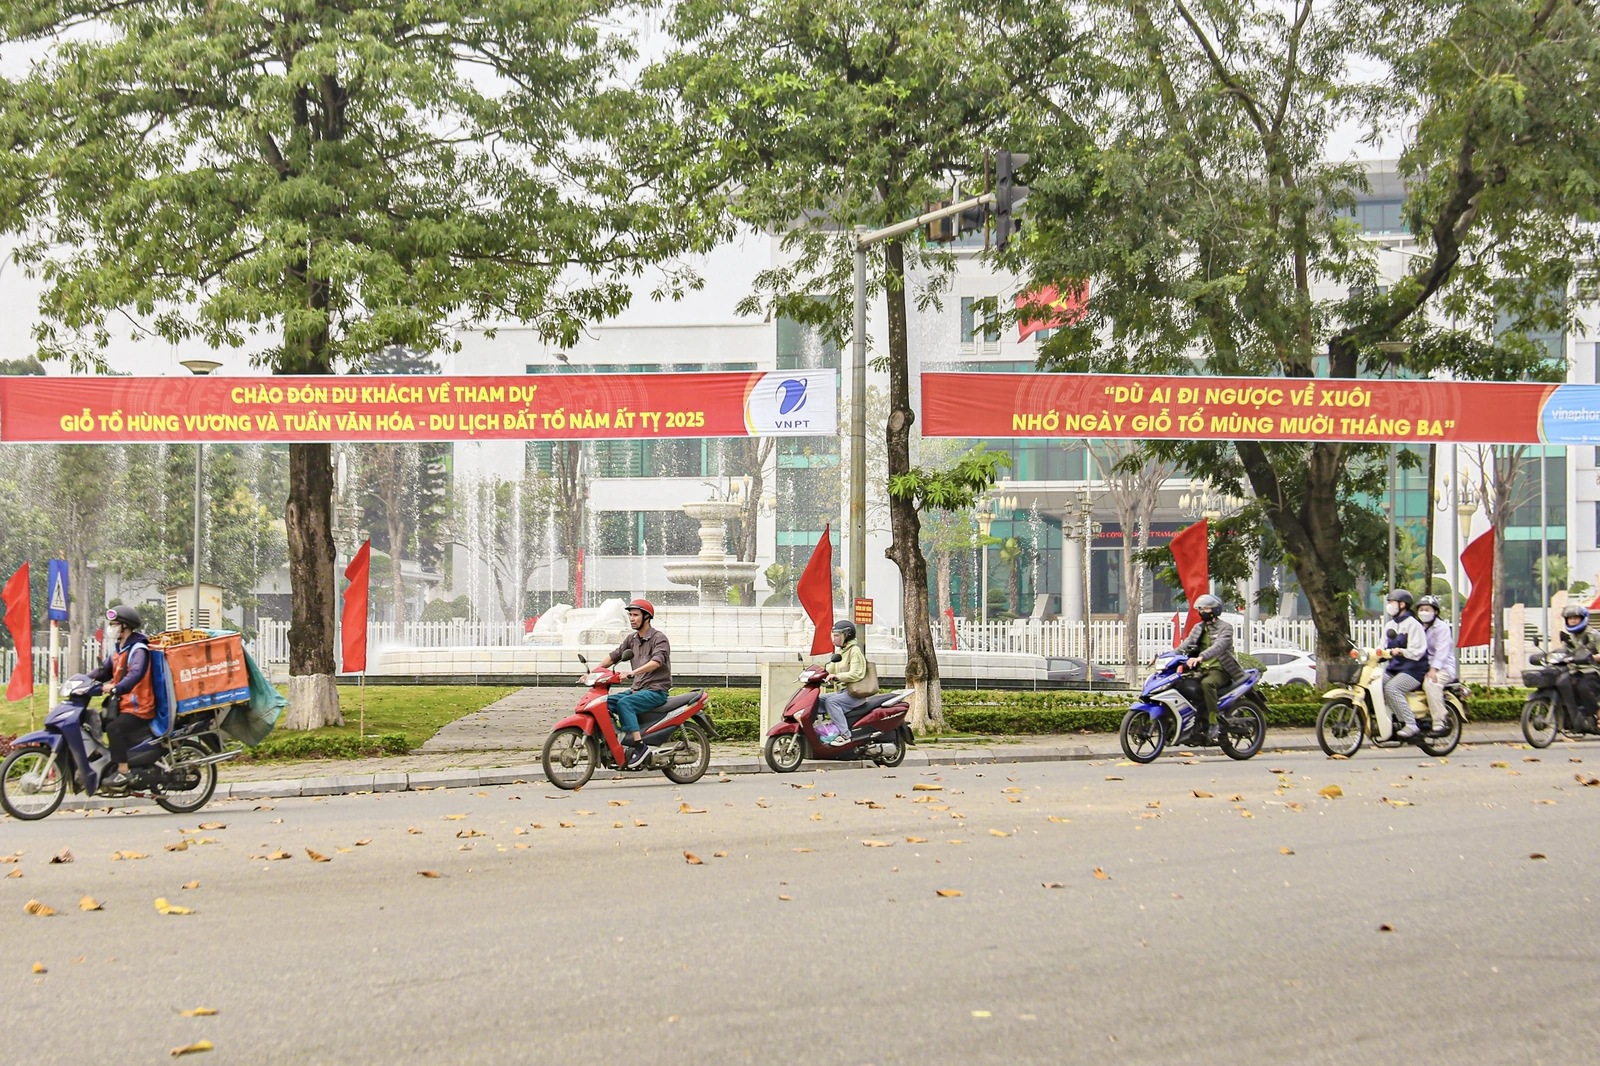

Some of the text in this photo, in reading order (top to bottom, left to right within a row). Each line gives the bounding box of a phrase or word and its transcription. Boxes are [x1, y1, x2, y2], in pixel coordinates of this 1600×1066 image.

[230, 381, 538, 407] CHÀO ĐÓN DU KHÁCH VỀ THAM DỰ
[1104, 381, 1372, 410] “DÙ AI ĐI NGƯỢC VỀ XUÔI
[59, 407, 95, 433] GIỖ
[97, 408, 124, 433] TỔ
[126, 410, 181, 433] HÙNG
[182, 413, 253, 433] VƯƠNG
[254, 410, 280, 432] VÀ
[282, 409, 333, 432] TUẦN
[335, 410, 373, 432] VĂN
[375, 410, 416, 432] HÓA
[429, 414, 456, 431] DU
[458, 413, 500, 435] LỊCH
[502, 408, 538, 431] ĐẤT
[540, 407, 566, 430] TỔ
[569, 408, 611, 430] NĂM
[613, 406, 638, 429] ẤT
[639, 411, 662, 433] TỴ
[665, 411, 705, 428] 2025
[774, 420, 811, 429] VNPT
[1012, 406, 1456, 437] NHỚ NGÀY GIỖ TỔ MÙNG MƯỜI THÁNG BA”
